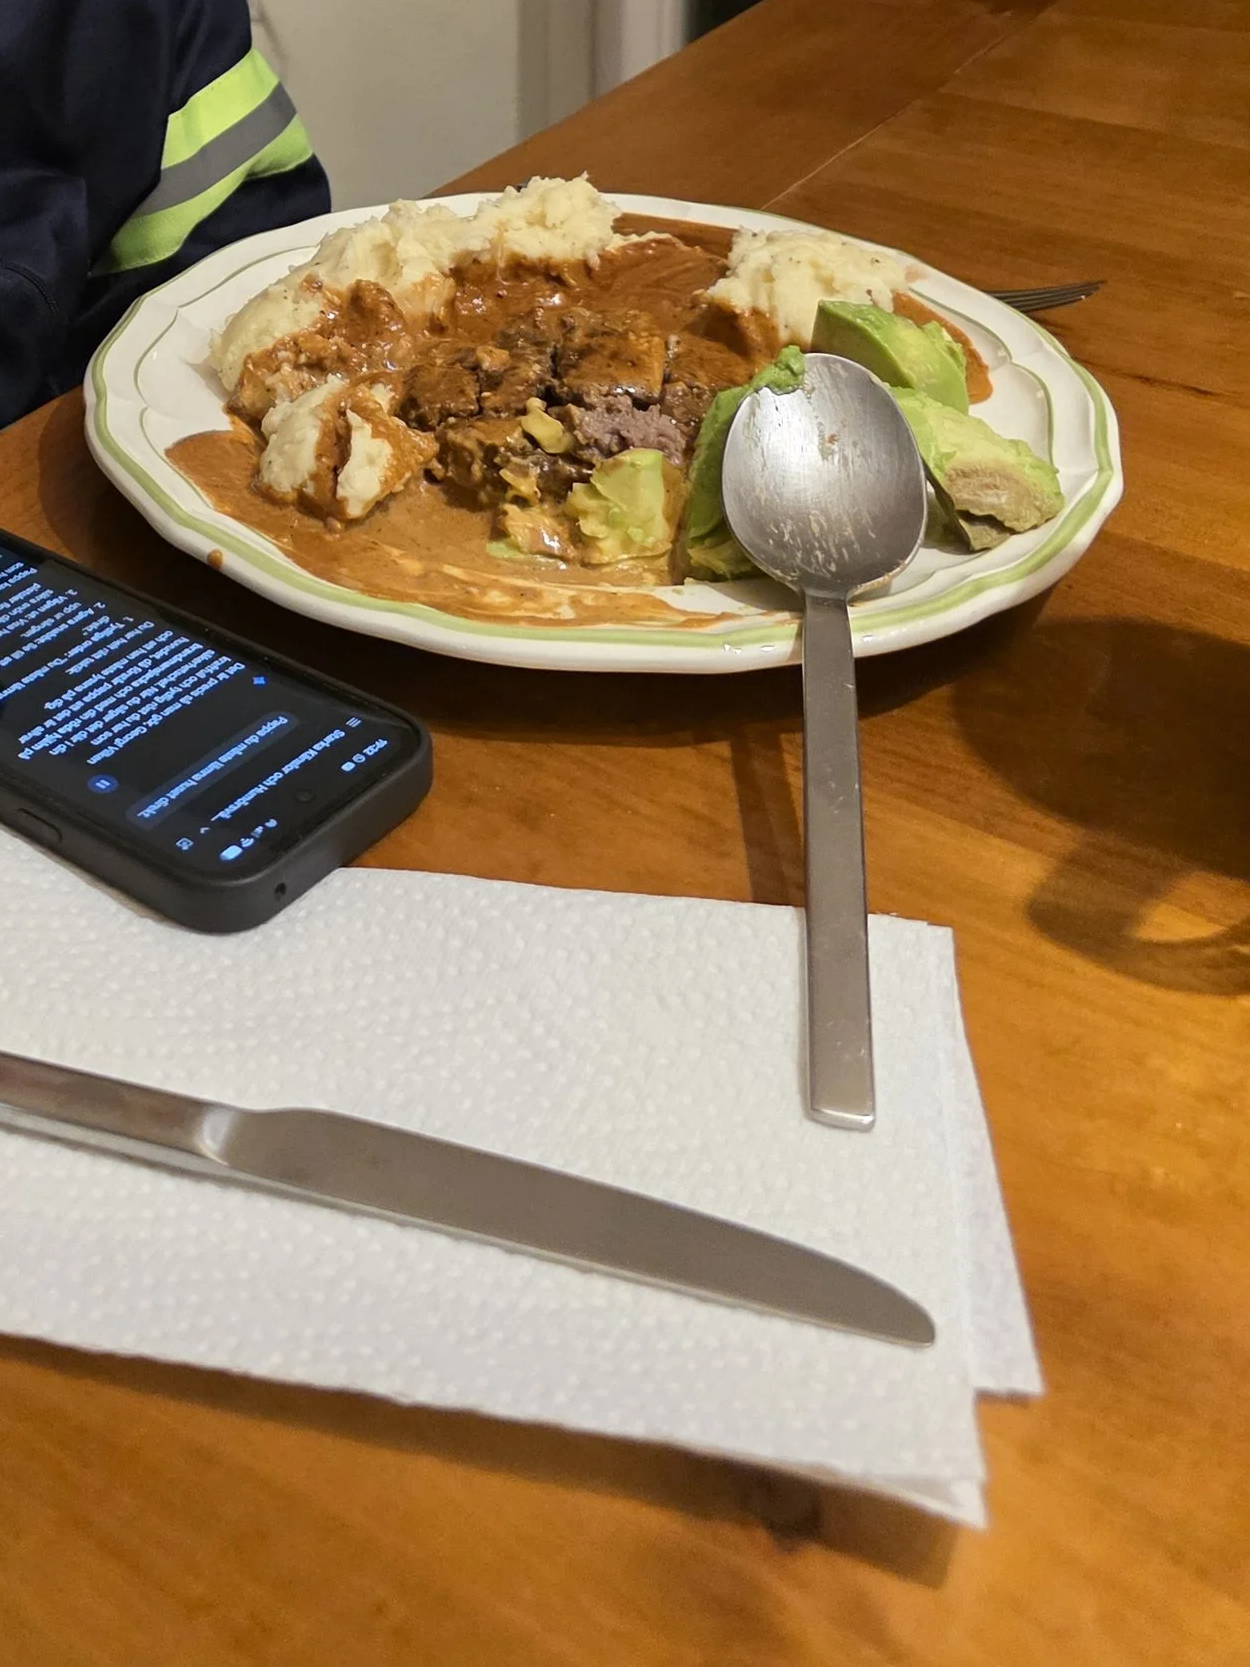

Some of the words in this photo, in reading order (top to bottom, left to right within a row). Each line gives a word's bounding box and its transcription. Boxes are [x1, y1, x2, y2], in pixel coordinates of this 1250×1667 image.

[5, 562, 24, 573] som
[8, 568, 37, 583] Pappa
[29, 590, 53, 603] säkra
[9, 603, 30, 615] snön
[38, 596, 68, 612] Vägen
[63, 603, 81, 613] upp
[25, 611, 39, 619] ut:
[67, 608, 94, 624] Agera
[6, 619, 28, 630] Visa
[21, 618, 54, 637] sängen.
[138, 621, 154, 630] Du
[91, 623, 125, 641] Tydliga
[125, 629, 142, 639] har
[155, 631, 173, 642] och
[22, 643, 38, 651] Se
[107, 638, 128, 650] helt
[142, 641, 157, 650] att
[149, 637, 189, 659] huvudet,
[11, 650, 25, 659] till
[91, 648, 109, 659] rätt
[126, 648, 147, 659] han
[101, 658, 129, 675] måste
[138, 659, 152, 668] då
[195, 656, 231, 678] kraftfull
[225, 663, 245, 674] Det
[21, 666, 50, 683] måste
[111, 666, 142, 685] förstår
[217, 672, 229, 680] är
[179, 676, 198, 688] och
[190, 678, 218, 697] precis
[62, 690, 76, 701] på
[82, 682, 112, 702] pappa
[114, 686, 133, 698] och
[140, 686, 159, 698] När
[154, 687, 183, 703] tydlig
[44, 699, 63, 709] dig.
[94, 696, 116, 712] med
[126, 697, 140, 706] du
[179, 695, 193, 704] så
[69, 701, 84, 711] att
[138, 701, 158, 715] röst
[160, 702, 182, 716] man
[53, 709, 71, 721] det
[79, 709, 96, 720] din
[103, 704, 128, 722] säger
[126, 713, 140, 722] du
[44, 719, 57, 728] är
[57, 718, 82, 733] röda
[85, 721, 103, 732] det
[143, 714, 163, 727] gör,
[256, 717, 288, 736] Pappa
[111, 721, 131, 733] har
[31, 732, 62, 750] hjälm
[70, 731, 88, 743] där
[90, 731, 113, 745] som
[244, 735, 259, 745] du
[313, 730, 345, 750] Starka
[49, 744, 67, 755] din
[218, 743, 247, 762] måste
[363, 739, 387, 755] 19:32
[18, 748, 34, 759] på
[87, 746, 119, 764] Vilken
[282, 749, 318, 774] Känslor
[192, 761, 224, 781] lämna
[263, 772, 283, 786] och
[166, 779, 198, 799] huset
[137, 797, 169, 817] direkt.
